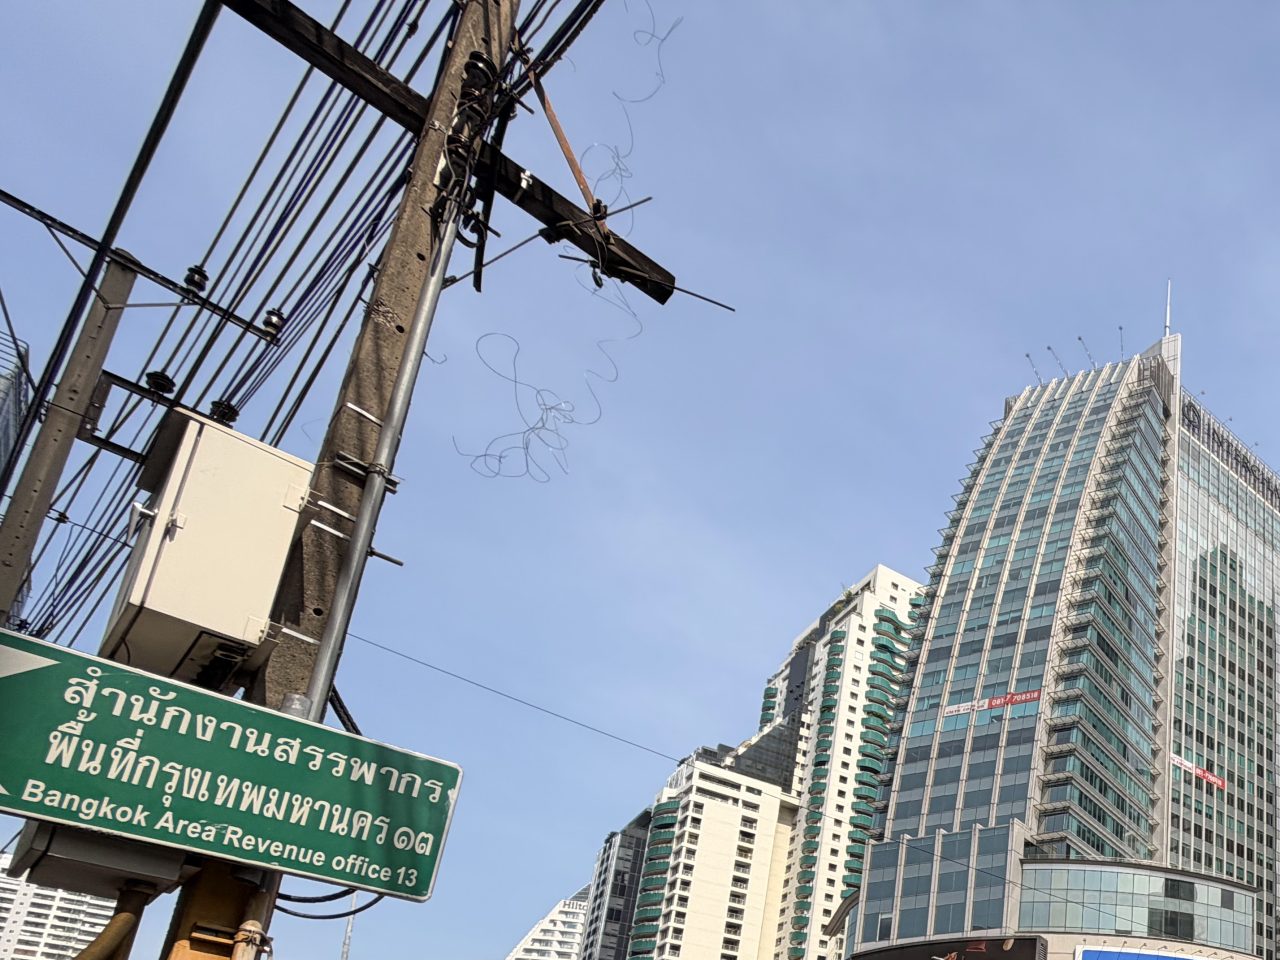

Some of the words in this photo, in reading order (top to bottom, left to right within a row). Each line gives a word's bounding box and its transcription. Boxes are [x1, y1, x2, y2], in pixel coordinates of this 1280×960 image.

[44, 709, 387, 851] พื้นที่กรุงเทพมหานคร
[63, 666, 448, 804] สำนักงานสรรพากร
[21, 779, 151, 828] Bangkok
[153, 807, 218, 844] Area
[225, 826, 326, 868] Revenue
[331, 853, 392, 883] office
[396, 866, 419, 888] 13
